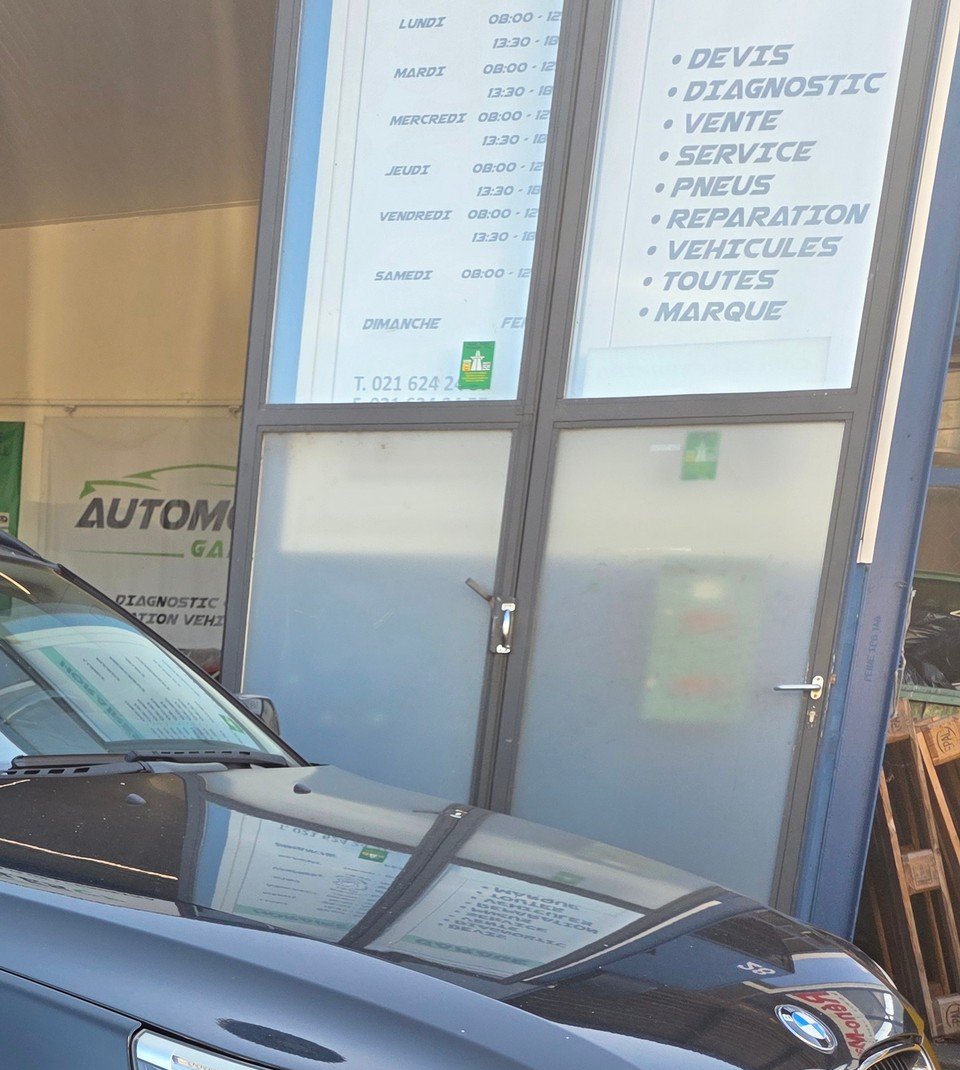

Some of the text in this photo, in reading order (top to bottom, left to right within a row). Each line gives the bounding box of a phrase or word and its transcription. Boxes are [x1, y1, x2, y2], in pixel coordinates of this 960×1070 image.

[398, 16, 446, 30] LUNDI
[488, 12, 534, 24] 08:00
[492, 36, 531, 48] 13:30
[688, 44, 794, 70] DEVIS
[394, 66, 446, 79] MARDI
[483, 62, 528, 74] 08:00
[487, 86, 525, 98] 13:30
[683, 72, 887, 102] DIAGNOSTIC
[390, 112, 468, 126] MERCREDI
[478, 111, 522, 122] 08:00
[686, 110, 784, 133] VENTE
[482, 135, 520, 146] 13:30
[675, 140, 817, 166] SERVICE
[384, 164, 431, 176] JEUDI
[472, 162, 517, 173] 08:00
[477, 185, 514, 196] 13:30
[670, 174, 776, 197] PNEUS
[380, 209, 453, 222] VENDREDI
[468, 209, 511, 220] 08:00
[666, 203, 870, 229] REPARATION
[472, 232, 509, 242] 13:30
[668, 236, 843, 260] VEHICULES
[374, 270, 433, 282] SAMEDI
[461, 268, 505, 279] 08:00
[663, 269, 779, 291] TOUTES
[654, 300, 788, 322] MARQUE
[362, 317, 442, 330] DIMANCHE
[354, 376, 366, 391] T.
[372, 376, 402, 391] 021
[408, 376, 439, 391] 624
[444, 376, 459, 391] 2
[191, 540, 230, 558] GA
[116, 594, 219, 608] DIAGNOSTIC
